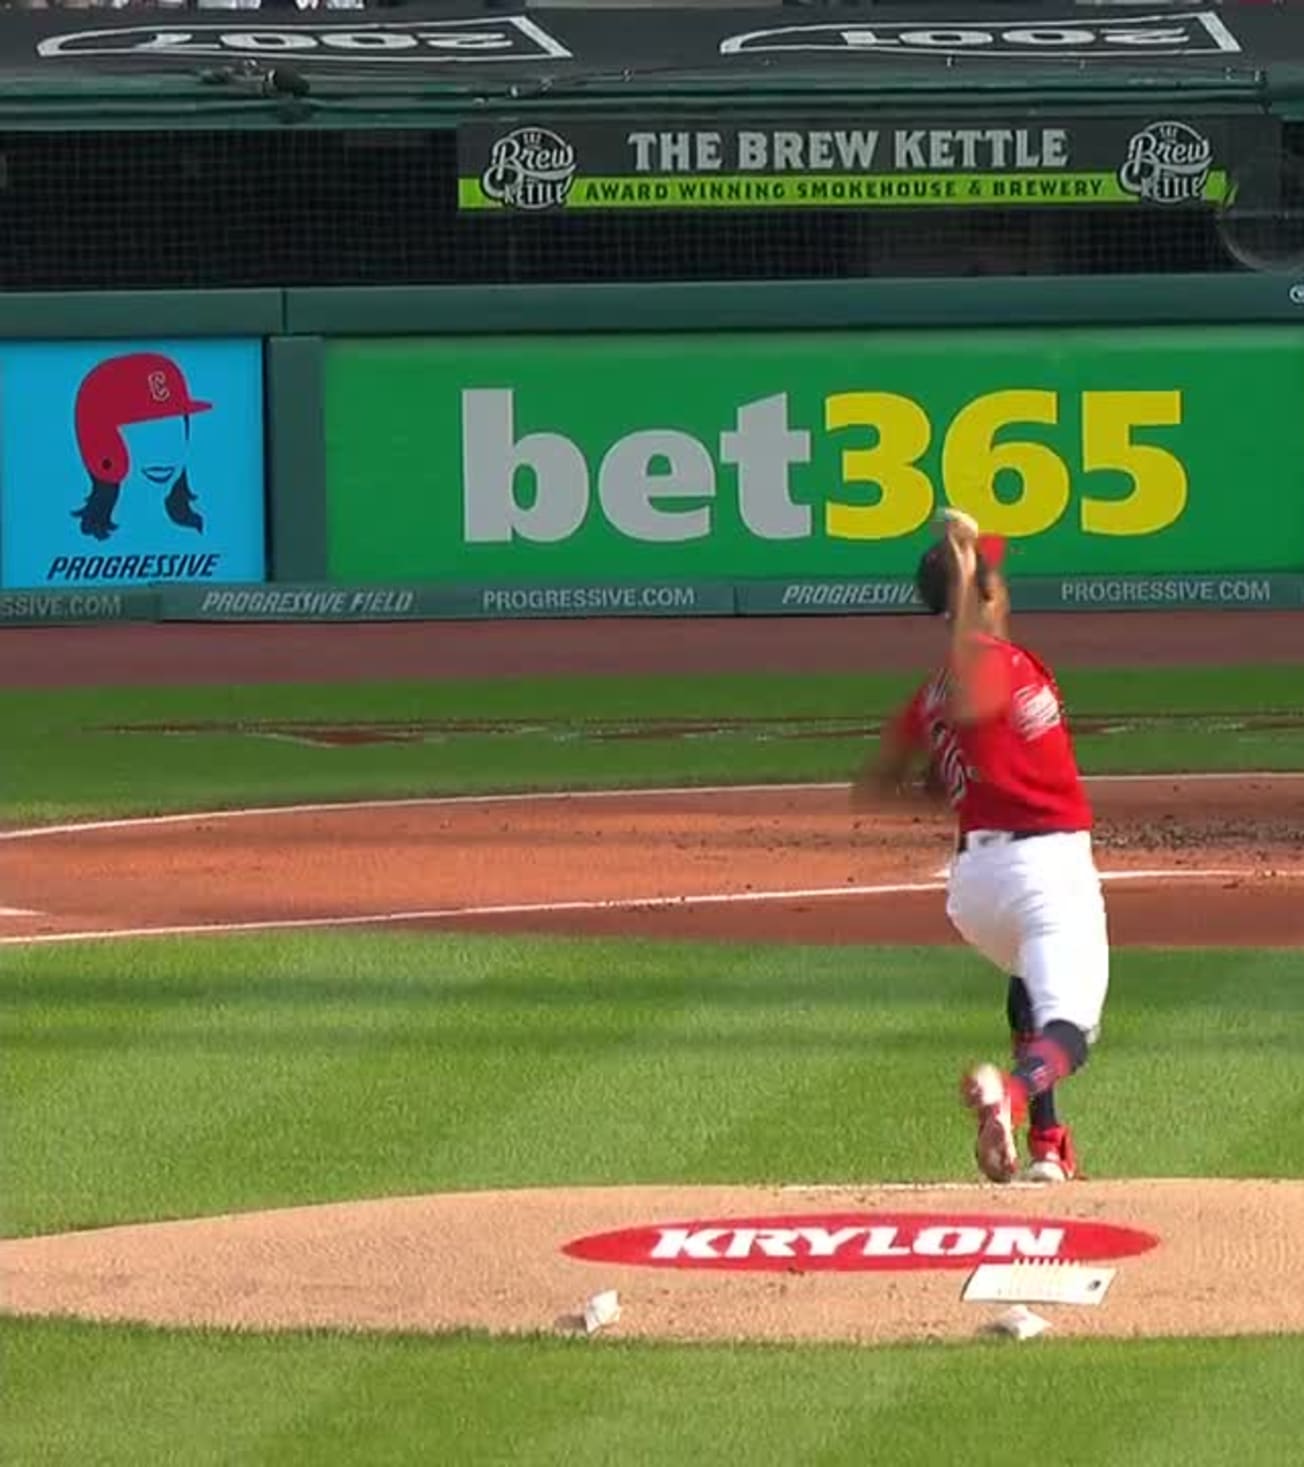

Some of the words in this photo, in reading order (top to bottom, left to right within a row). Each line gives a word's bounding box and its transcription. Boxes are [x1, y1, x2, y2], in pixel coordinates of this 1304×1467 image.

[840, 28, 1190, 45] 2001
[490, 137, 575, 180] Brew
[627, 131, 722, 171] THE
[738, 130, 879, 170] BREW
[895, 128, 1068, 168] KETTLE
[1128, 131, 1209, 174] Brew
[585, 182, 669, 201] AWARD
[680, 181, 786, 200] WINNING
[797, 180, 953, 199] SMOKEHOUSE
[968, 179, 982, 196] &
[993, 178, 1103, 197] BREWERY
[461, 388, 1188, 542] bet365
[47, 553, 221, 581] PROGRESSIVE
[201, 591, 347, 613] PROGRESSIVE
[350, 591, 414, 613] FIELD
[483, 587, 695, 610] PROGRESSIVE.COM
[1060, 580, 1270, 601] PROGRESSIVE.COM
[649, 1226, 1066, 1260] KRYLON
